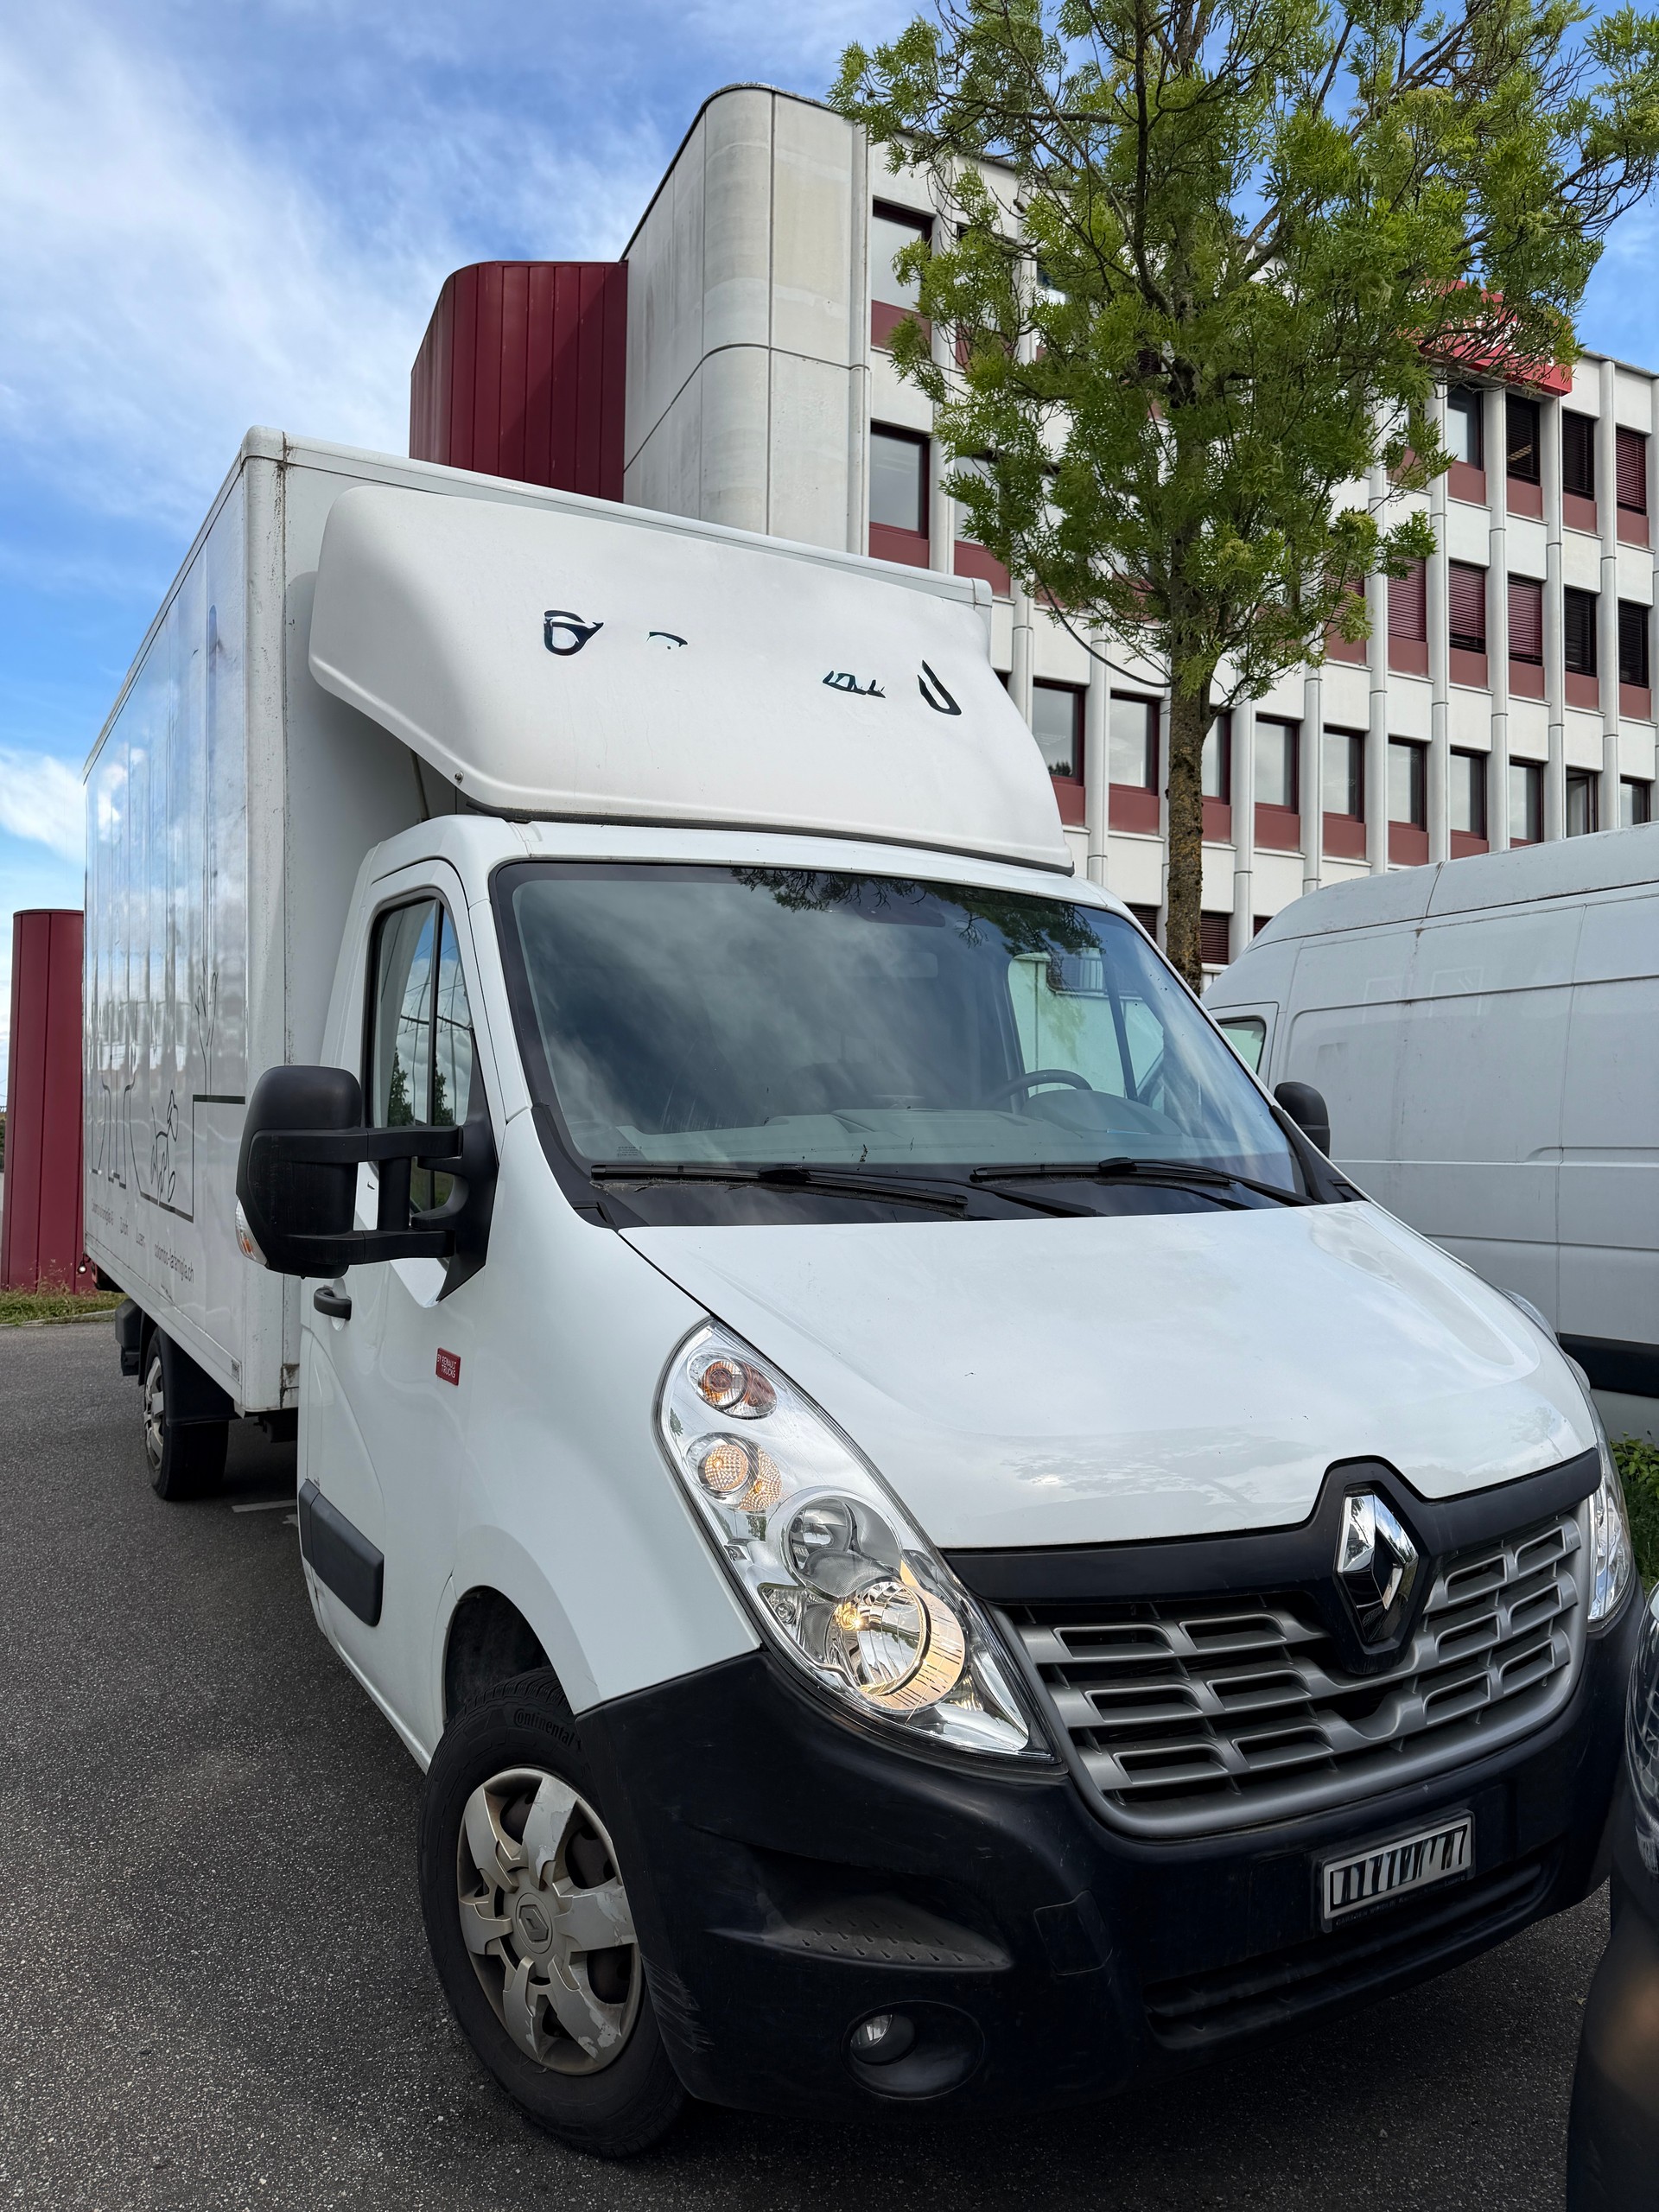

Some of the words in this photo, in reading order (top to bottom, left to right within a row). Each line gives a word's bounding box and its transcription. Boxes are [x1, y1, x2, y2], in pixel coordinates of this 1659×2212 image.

[442, 1356, 456, 1370] RENAULT
[441, 1364, 456, 1378] TRUCKS
[513, 1708, 575, 1747] Continental
